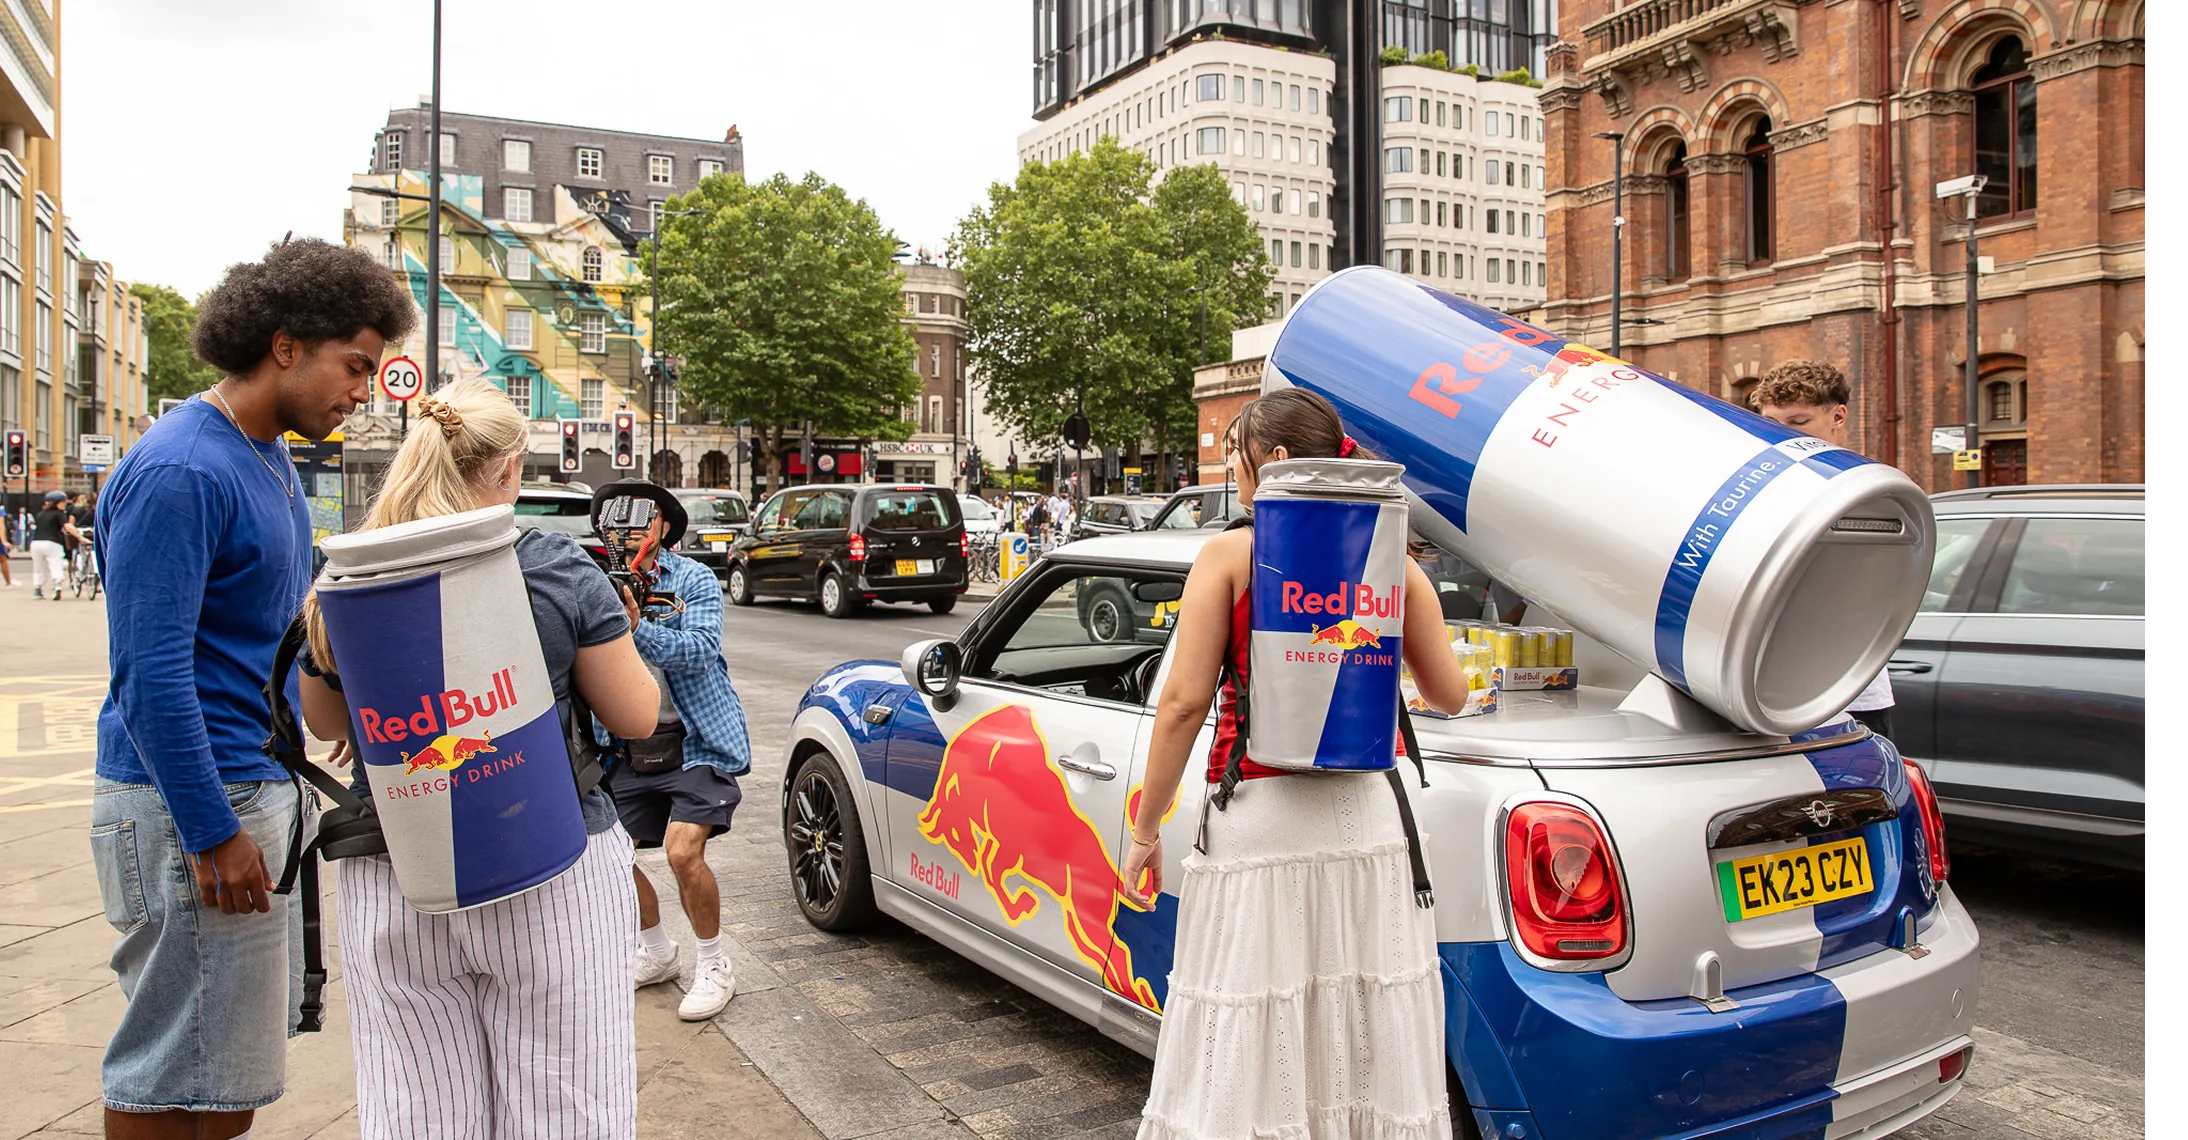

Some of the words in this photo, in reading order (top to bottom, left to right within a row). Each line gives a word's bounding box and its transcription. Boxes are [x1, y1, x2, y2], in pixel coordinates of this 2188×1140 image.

[389, 370, 416, 388] 20
[1408, 318, 1559, 420] Red
[880, 443, 905, 453] HSBC
[920, 443, 935, 453] UK
[1678, 523, 1719, 569] With
[1707, 460, 1783, 518] Taurine.
[1282, 581, 1348, 615] Red
[1354, 584, 1401, 619] Bull
[1285, 651, 1350, 664] ENERGY
[1355, 654, 1393, 666] DRINK
[1513, 672, 1527, 680] Red
[1527, 672, 1540, 680] Bull
[358, 695, 440, 745] Red
[438, 668, 518, 729] Bull
[387, 774, 460, 800] ENERGY
[468, 751, 527, 783] DRINK
[910, 852, 934, 887] Red
[936, 865, 960, 900] Bull
[1739, 856, 1814, 909] EK23
[1817, 844, 1864, 893] CZY
